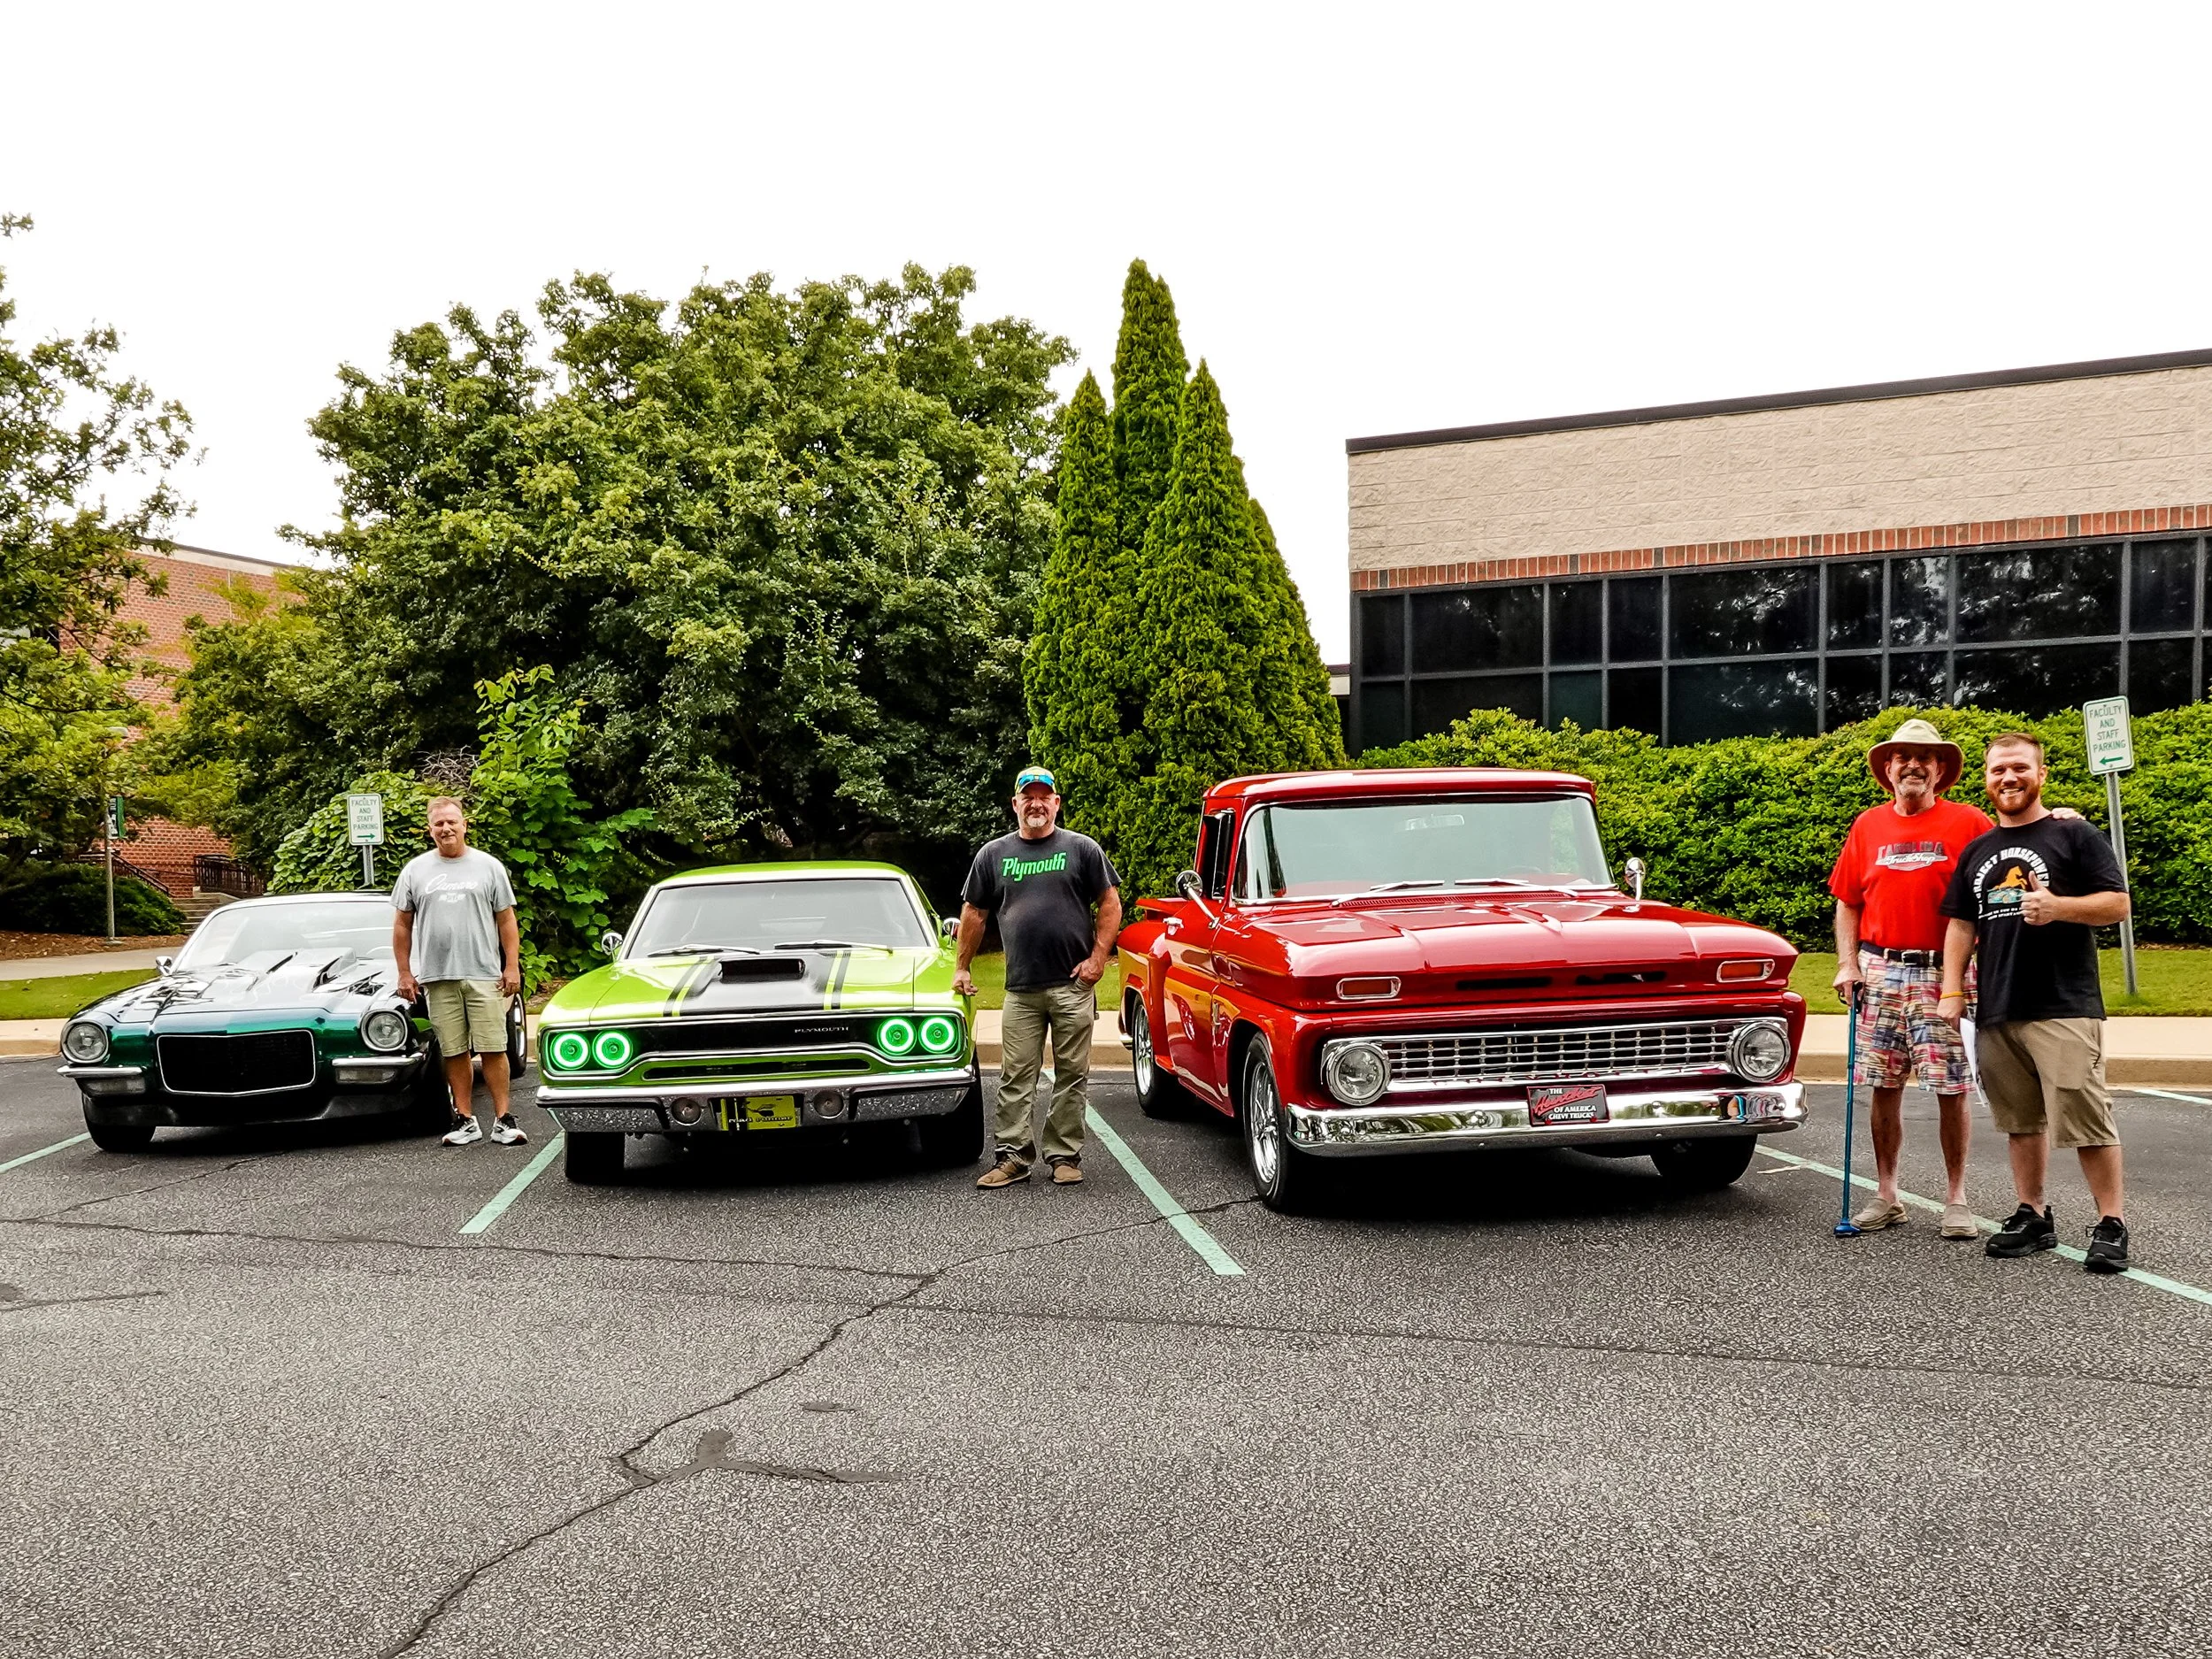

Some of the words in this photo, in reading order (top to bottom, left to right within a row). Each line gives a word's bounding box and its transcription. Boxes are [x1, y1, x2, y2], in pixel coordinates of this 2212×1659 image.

[2089, 705, 2123, 718] FACULTY
[2100, 718, 2116, 729] AND
[2097, 729, 2119, 741] STAFF
[2093, 740, 2126, 753] PARKING
[1002, 852, 1067, 882] Plymouth
